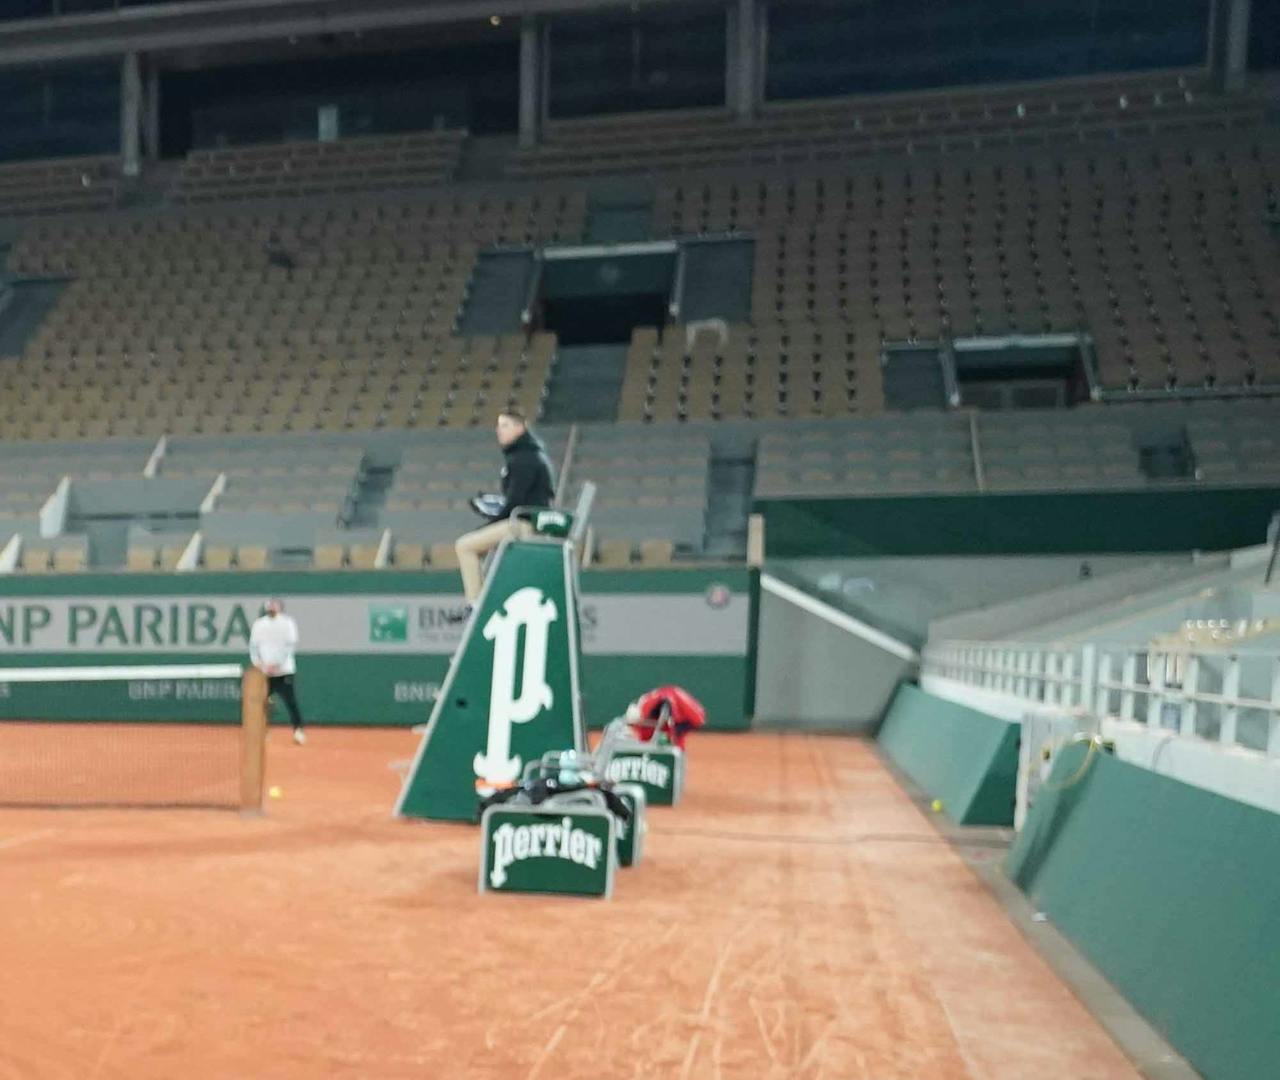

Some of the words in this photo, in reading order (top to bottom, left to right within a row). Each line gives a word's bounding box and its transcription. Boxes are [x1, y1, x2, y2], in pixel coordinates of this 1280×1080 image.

[67, 604, 266, 646] PARIBA
[605, 752, 671, 789] errier
[490, 816, 603, 888] perrier
